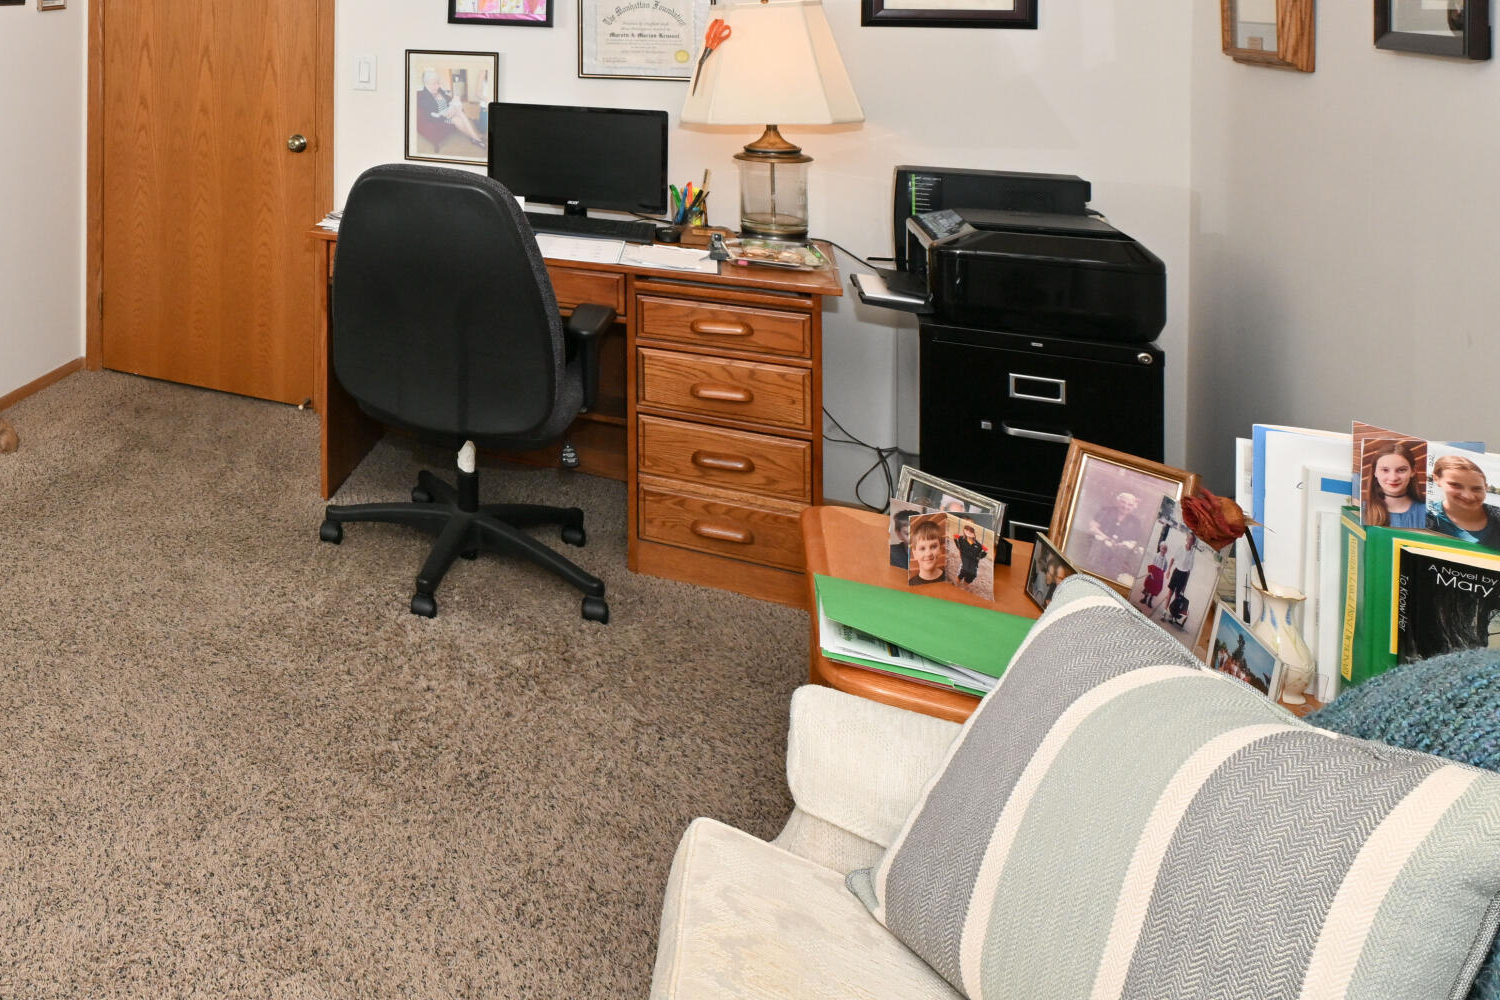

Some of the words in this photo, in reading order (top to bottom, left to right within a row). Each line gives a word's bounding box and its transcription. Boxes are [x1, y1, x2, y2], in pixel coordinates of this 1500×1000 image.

[1399, 574, 1409, 586] To
[1428, 564, 1438, 572] A
[1441, 566, 1478, 580] Novel
[1482, 576, 1498, 586] by
[1436, 573, 1494, 598] Mary
[1398, 588, 1409, 614] Know
